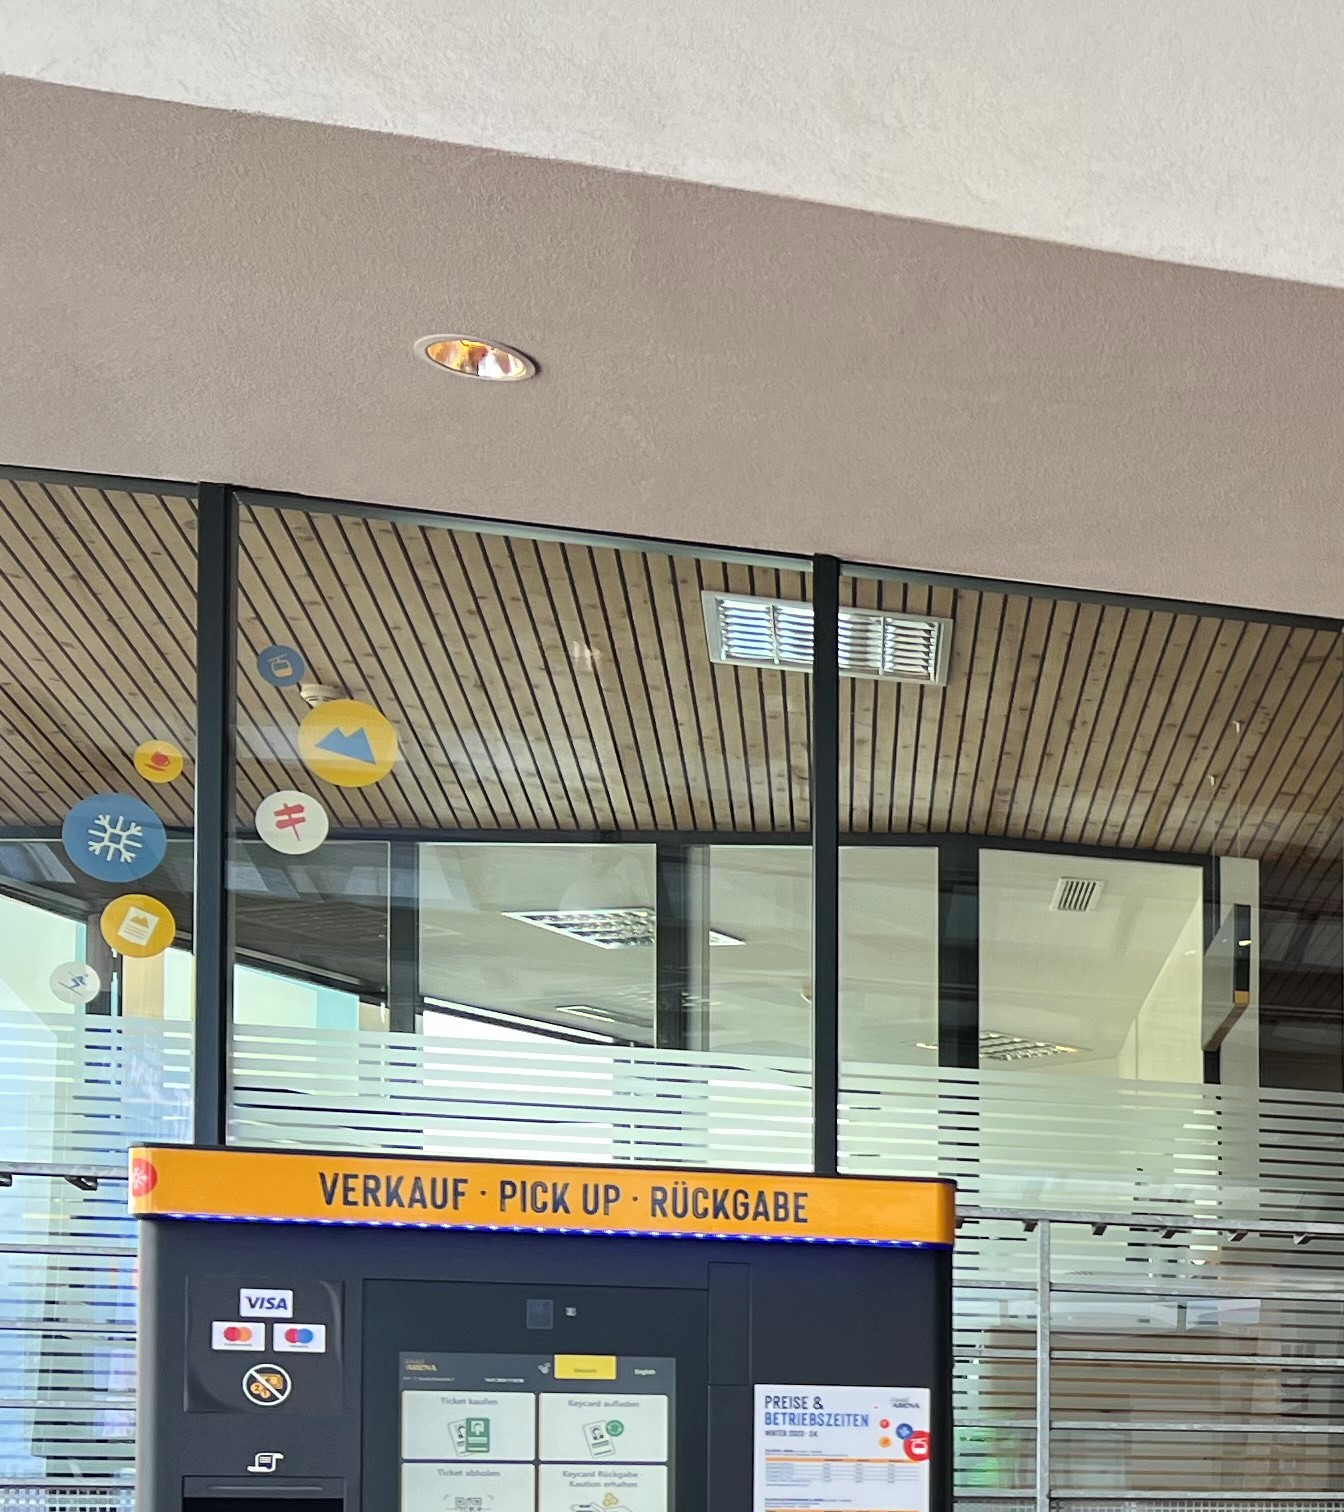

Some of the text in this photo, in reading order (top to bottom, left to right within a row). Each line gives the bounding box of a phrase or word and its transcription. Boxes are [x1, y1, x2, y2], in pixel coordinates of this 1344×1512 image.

[319, 1171, 809, 1225] VERKAUF PICK UP RÜCKGABE
[245, 1296, 288, 1310] VISA
[764, 1395, 824, 1410] PREISE &
[764, 1411, 869, 1427] BETRIEBSZEITEN
